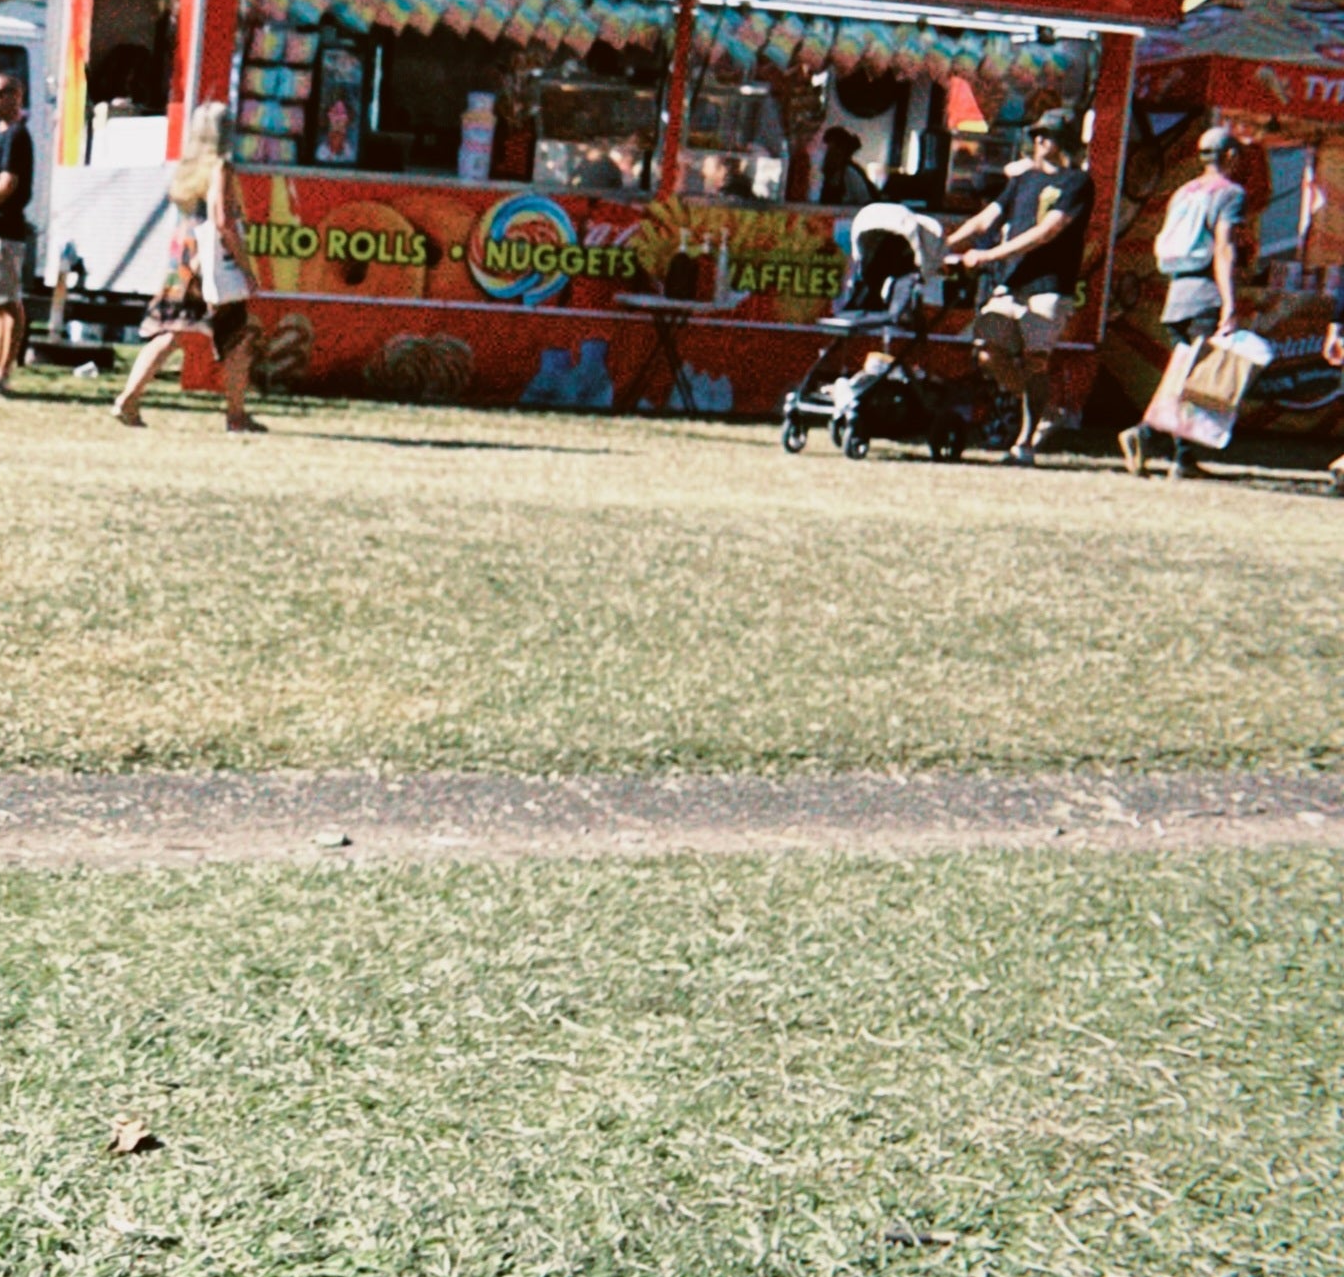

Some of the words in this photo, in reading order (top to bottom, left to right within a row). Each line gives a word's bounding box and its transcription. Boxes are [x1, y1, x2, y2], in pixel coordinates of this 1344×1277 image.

[327, 229, 428, 265] ROLLS
[485, 239, 636, 277] NUGGETS
[729, 262, 840, 297] AFFLES
